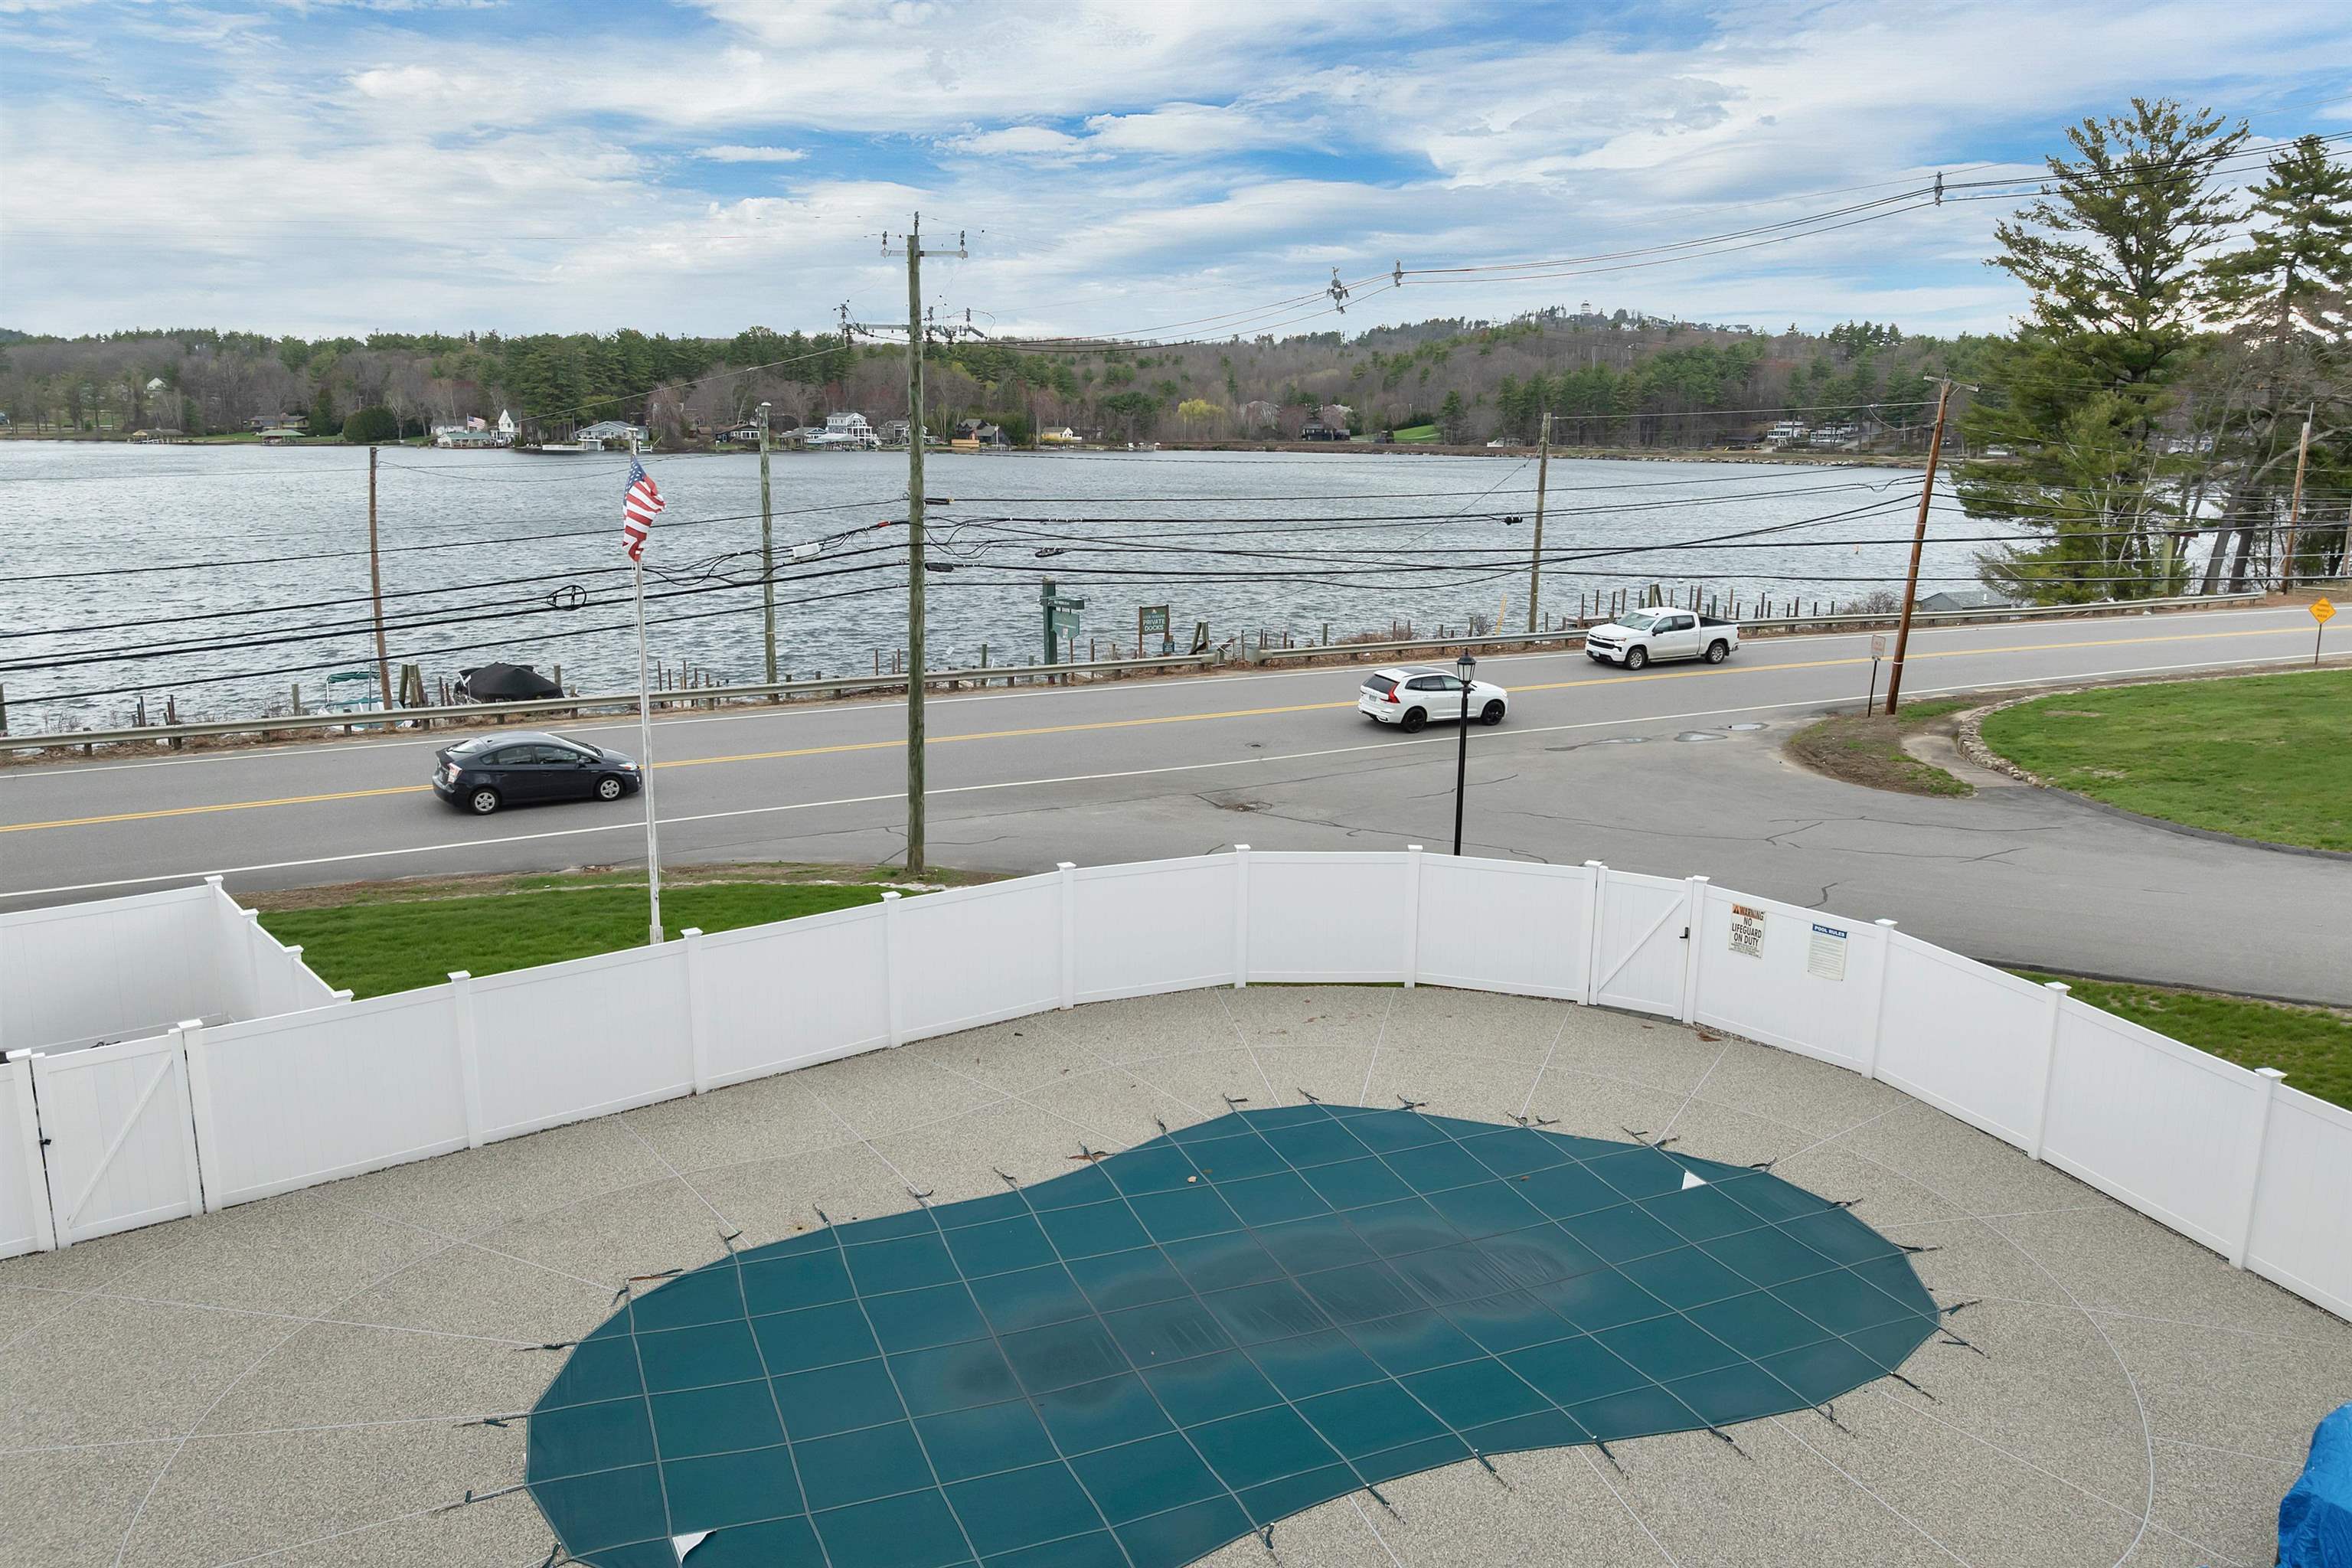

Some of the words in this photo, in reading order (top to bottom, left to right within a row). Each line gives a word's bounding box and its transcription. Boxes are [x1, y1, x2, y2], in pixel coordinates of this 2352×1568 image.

[1740, 906, 1764, 921] WARNING
[1743, 916, 1753, 926] NO
[1732, 923, 1762, 939] LIFEGUARD
[1814, 925, 1828, 933] POOL
[1828, 929, 1845, 937] RULES
[1733, 933, 1743, 942] ON
[1744, 935, 1759, 946] DUTY
